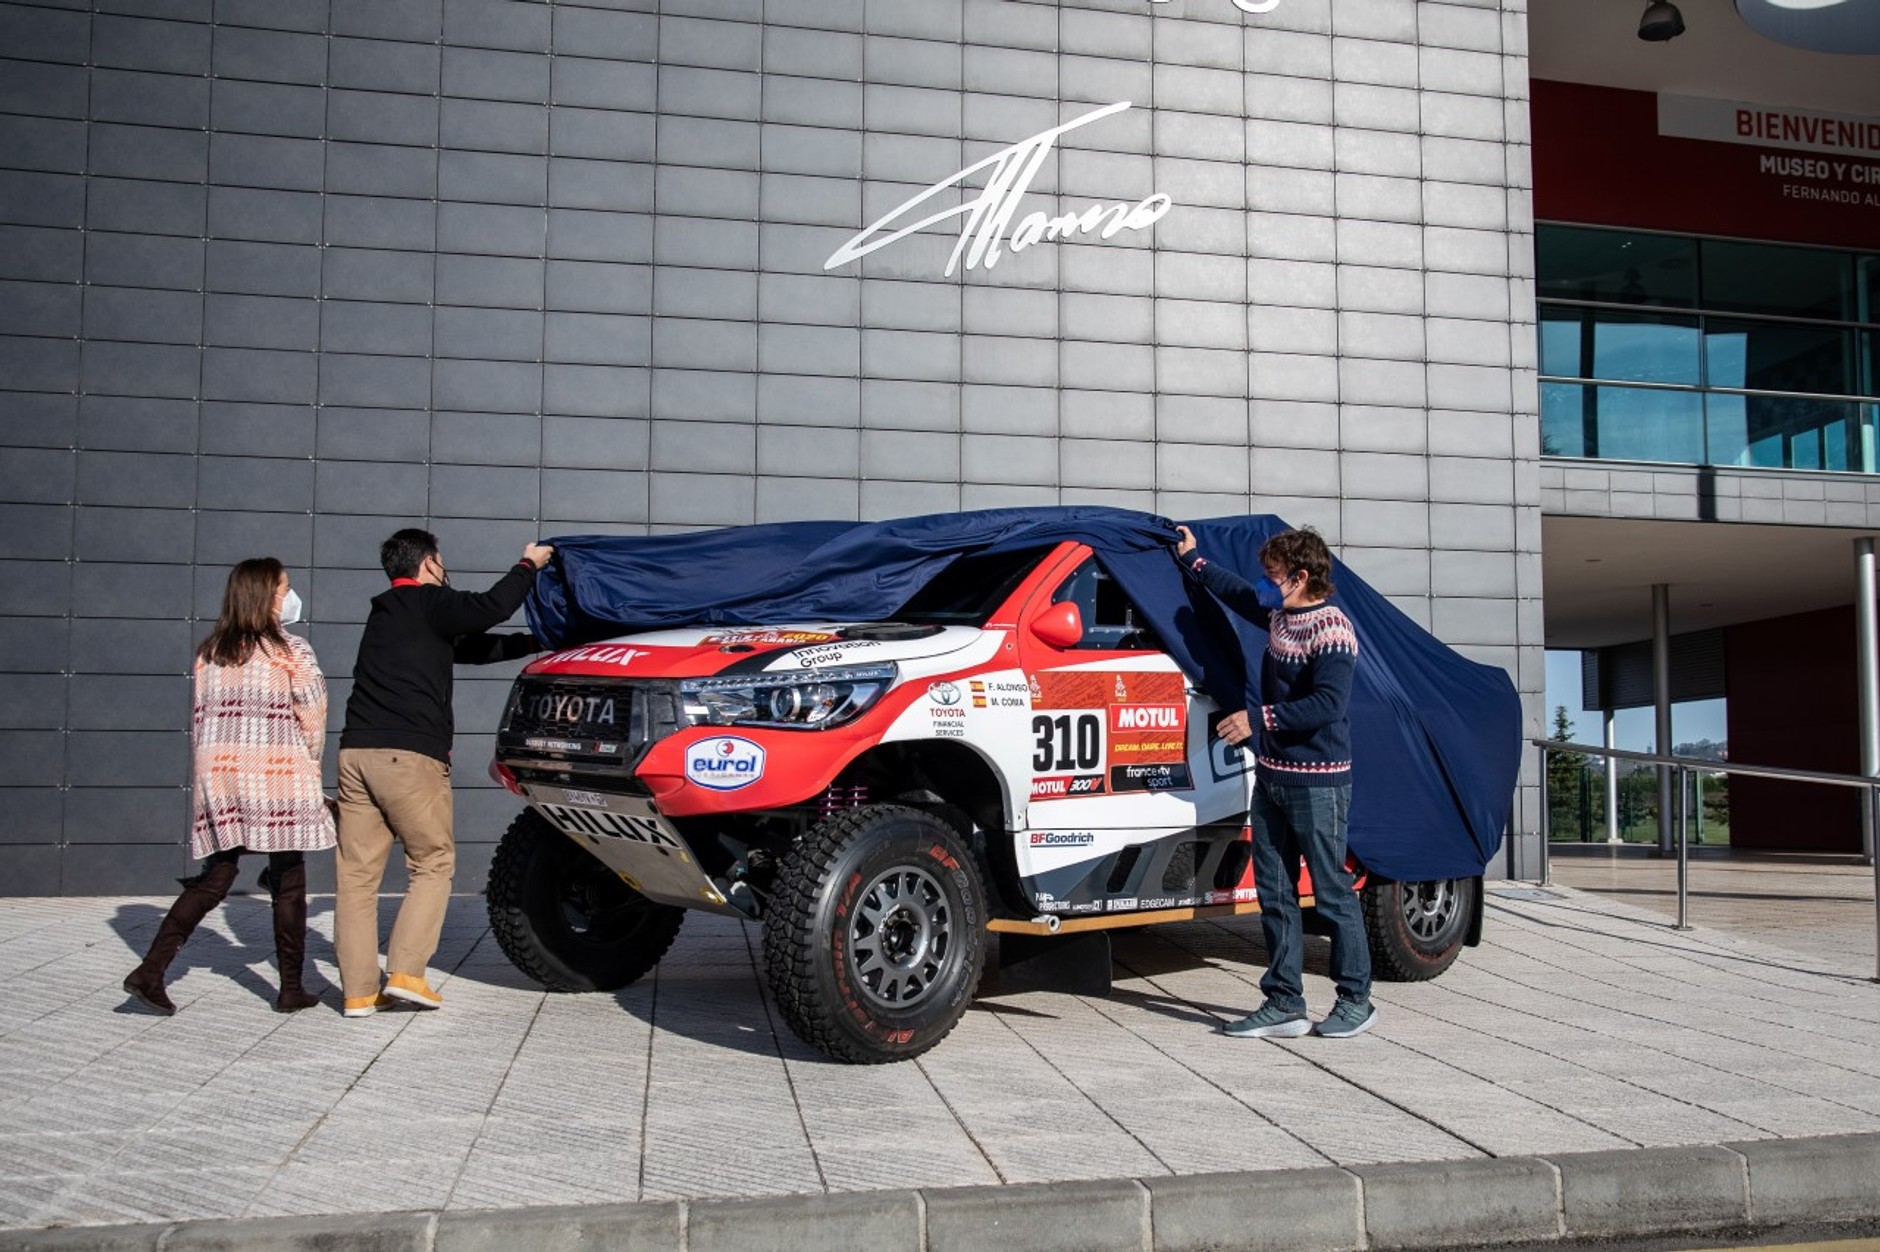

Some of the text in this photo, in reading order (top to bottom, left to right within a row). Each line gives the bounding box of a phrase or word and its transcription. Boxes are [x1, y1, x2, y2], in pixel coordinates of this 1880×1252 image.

[1736, 109, 1880, 151] BIENVENID
[1760, 154, 1829, 179] MUSEO
[1833, 162, 1847, 181] Y
[1783, 184, 1860, 205] FERNANDO
[792, 640, 881, 658] Innovation
[800, 651, 843, 668] Group
[997, 683, 1028, 692] ALONSO
[527, 695, 614, 724] TOYOTA
[930, 708, 966, 717] TOYOTA
[1118, 708, 1179, 728] MOTUL
[1032, 714, 1100, 772] 310
[693, 755, 757, 772] eurol
[1032, 781, 1066, 795] MOTUL
[1147, 776, 1173, 790] sport
[541, 804, 680, 847] HILUX
[1031, 832, 1094, 844] BFGoodrich
[1140, 897, 1175, 909] EDGECAM
